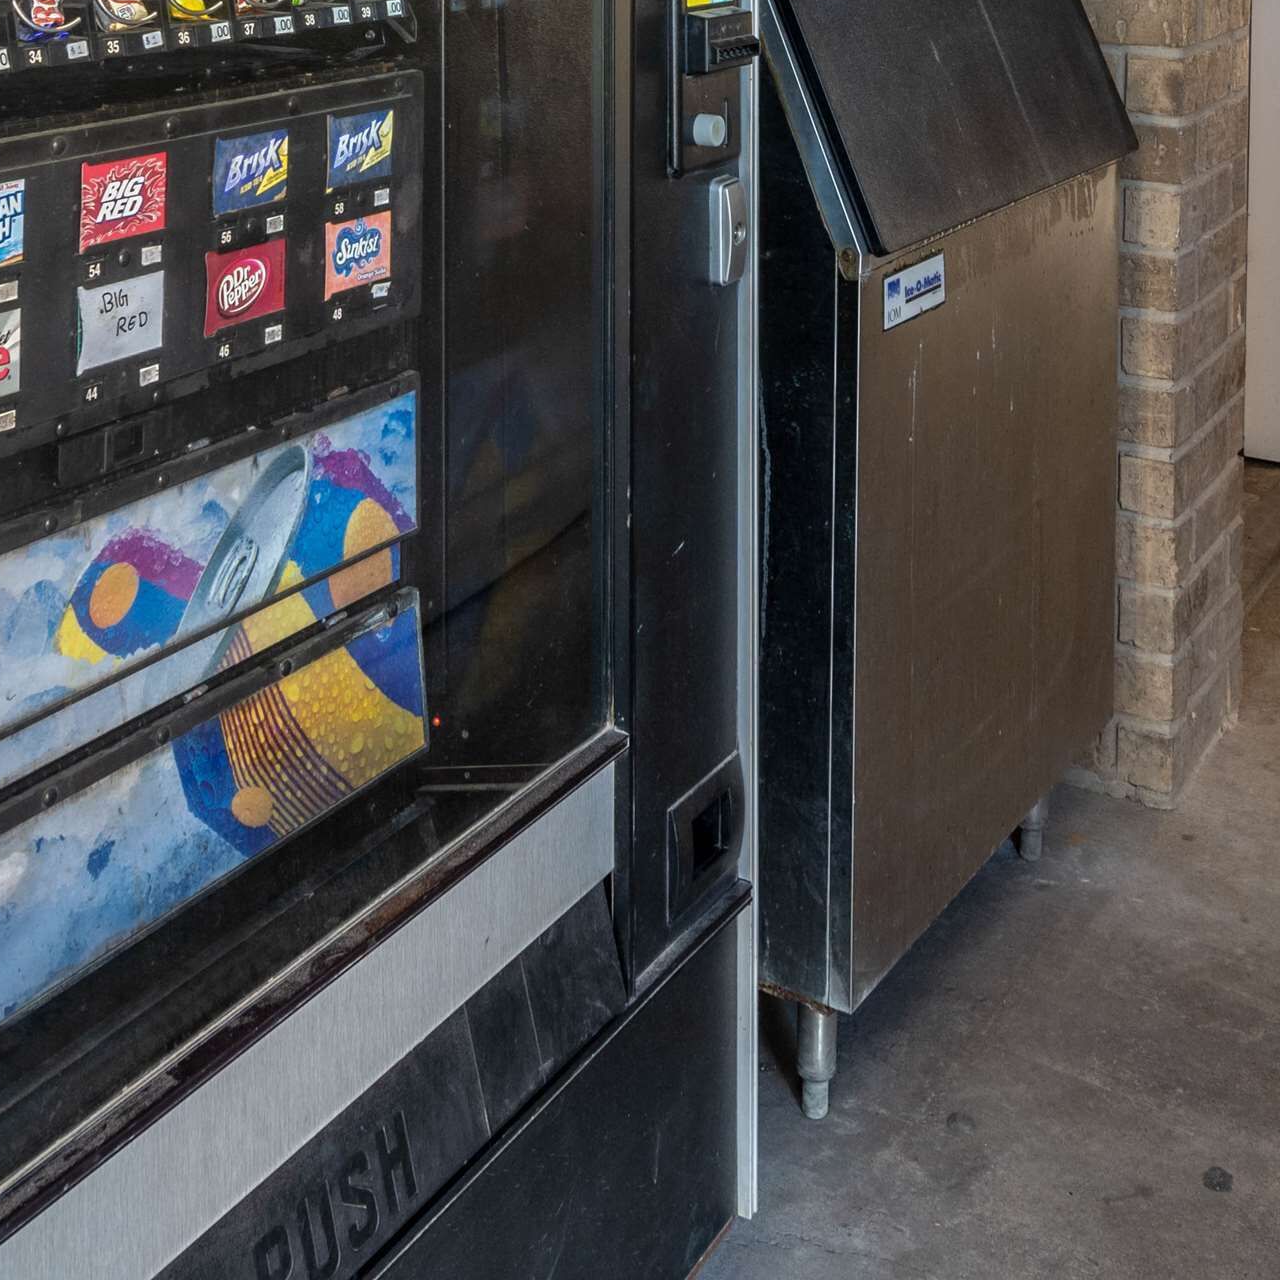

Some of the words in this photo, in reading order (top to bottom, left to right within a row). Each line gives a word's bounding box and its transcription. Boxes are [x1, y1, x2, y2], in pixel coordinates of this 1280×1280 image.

[361, 7, 371, 18] 39
[305, 15, 316, 26] 38
[244, 23, 255, 35] 37
[178, 31, 191, 44] 36
[106, 40, 120, 54] 35
[28, 50, 43, 64] 34
[101, 176, 145, 203] BIG
[96, 195, 144, 223] RED
[334, 202, 345, 215] 58
[220, 230, 232, 244] 56
[336, 233, 380, 265] Sunkist
[88, 263, 101, 278] 54
[233, 265, 252, 288] Dr
[223, 268, 262, 311] Pepper
[904, 271, 942, 298] Ice-O-Matic
[332, 307, 343, 320] 48
[115, 311, 148, 337] RED
[219, 344, 230, 358] 46
[85, 387, 98, 401] 44
[252, 1108, 419, 1280] PUSH
